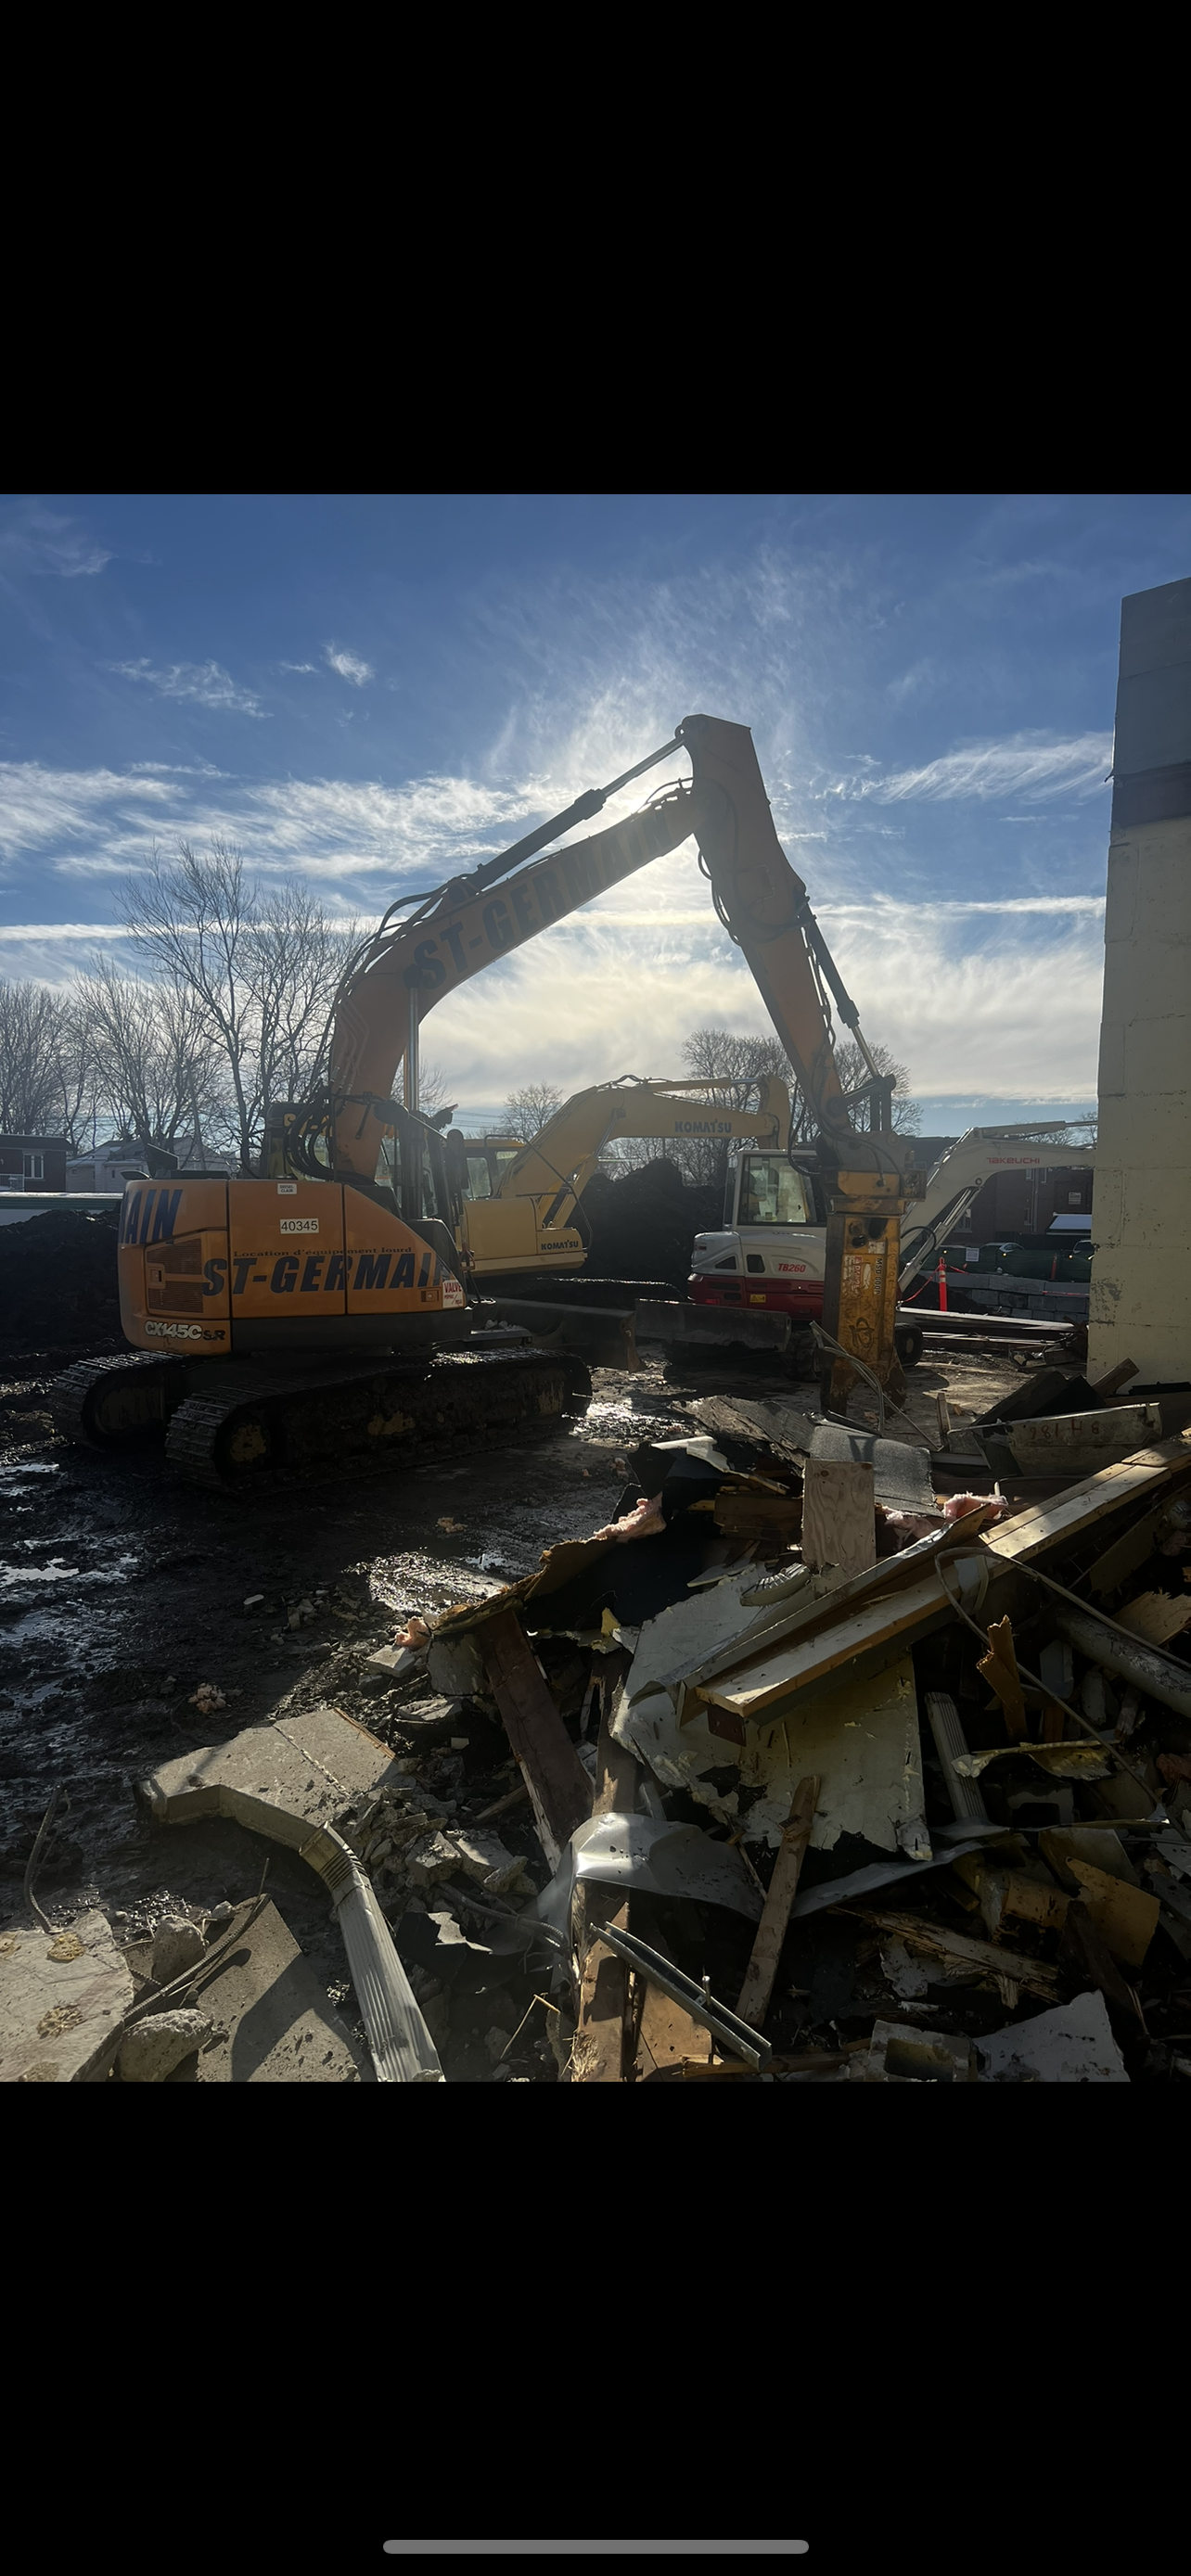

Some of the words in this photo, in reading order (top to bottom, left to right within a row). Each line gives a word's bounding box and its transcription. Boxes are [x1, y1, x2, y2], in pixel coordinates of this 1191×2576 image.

[412, 810, 673, 989] ST-GERMAIN
[674, 1118, 732, 1134] KOMATSU
[121, 1189, 185, 1244] AIN
[280, 1220, 318, 1231] 40345
[541, 1239, 579, 1251] KOMATSU
[777, 1263, 807, 1273] TB260
[443, 1282, 462, 1293] VALVE
[145, 1320, 203, 1341] CX145C
